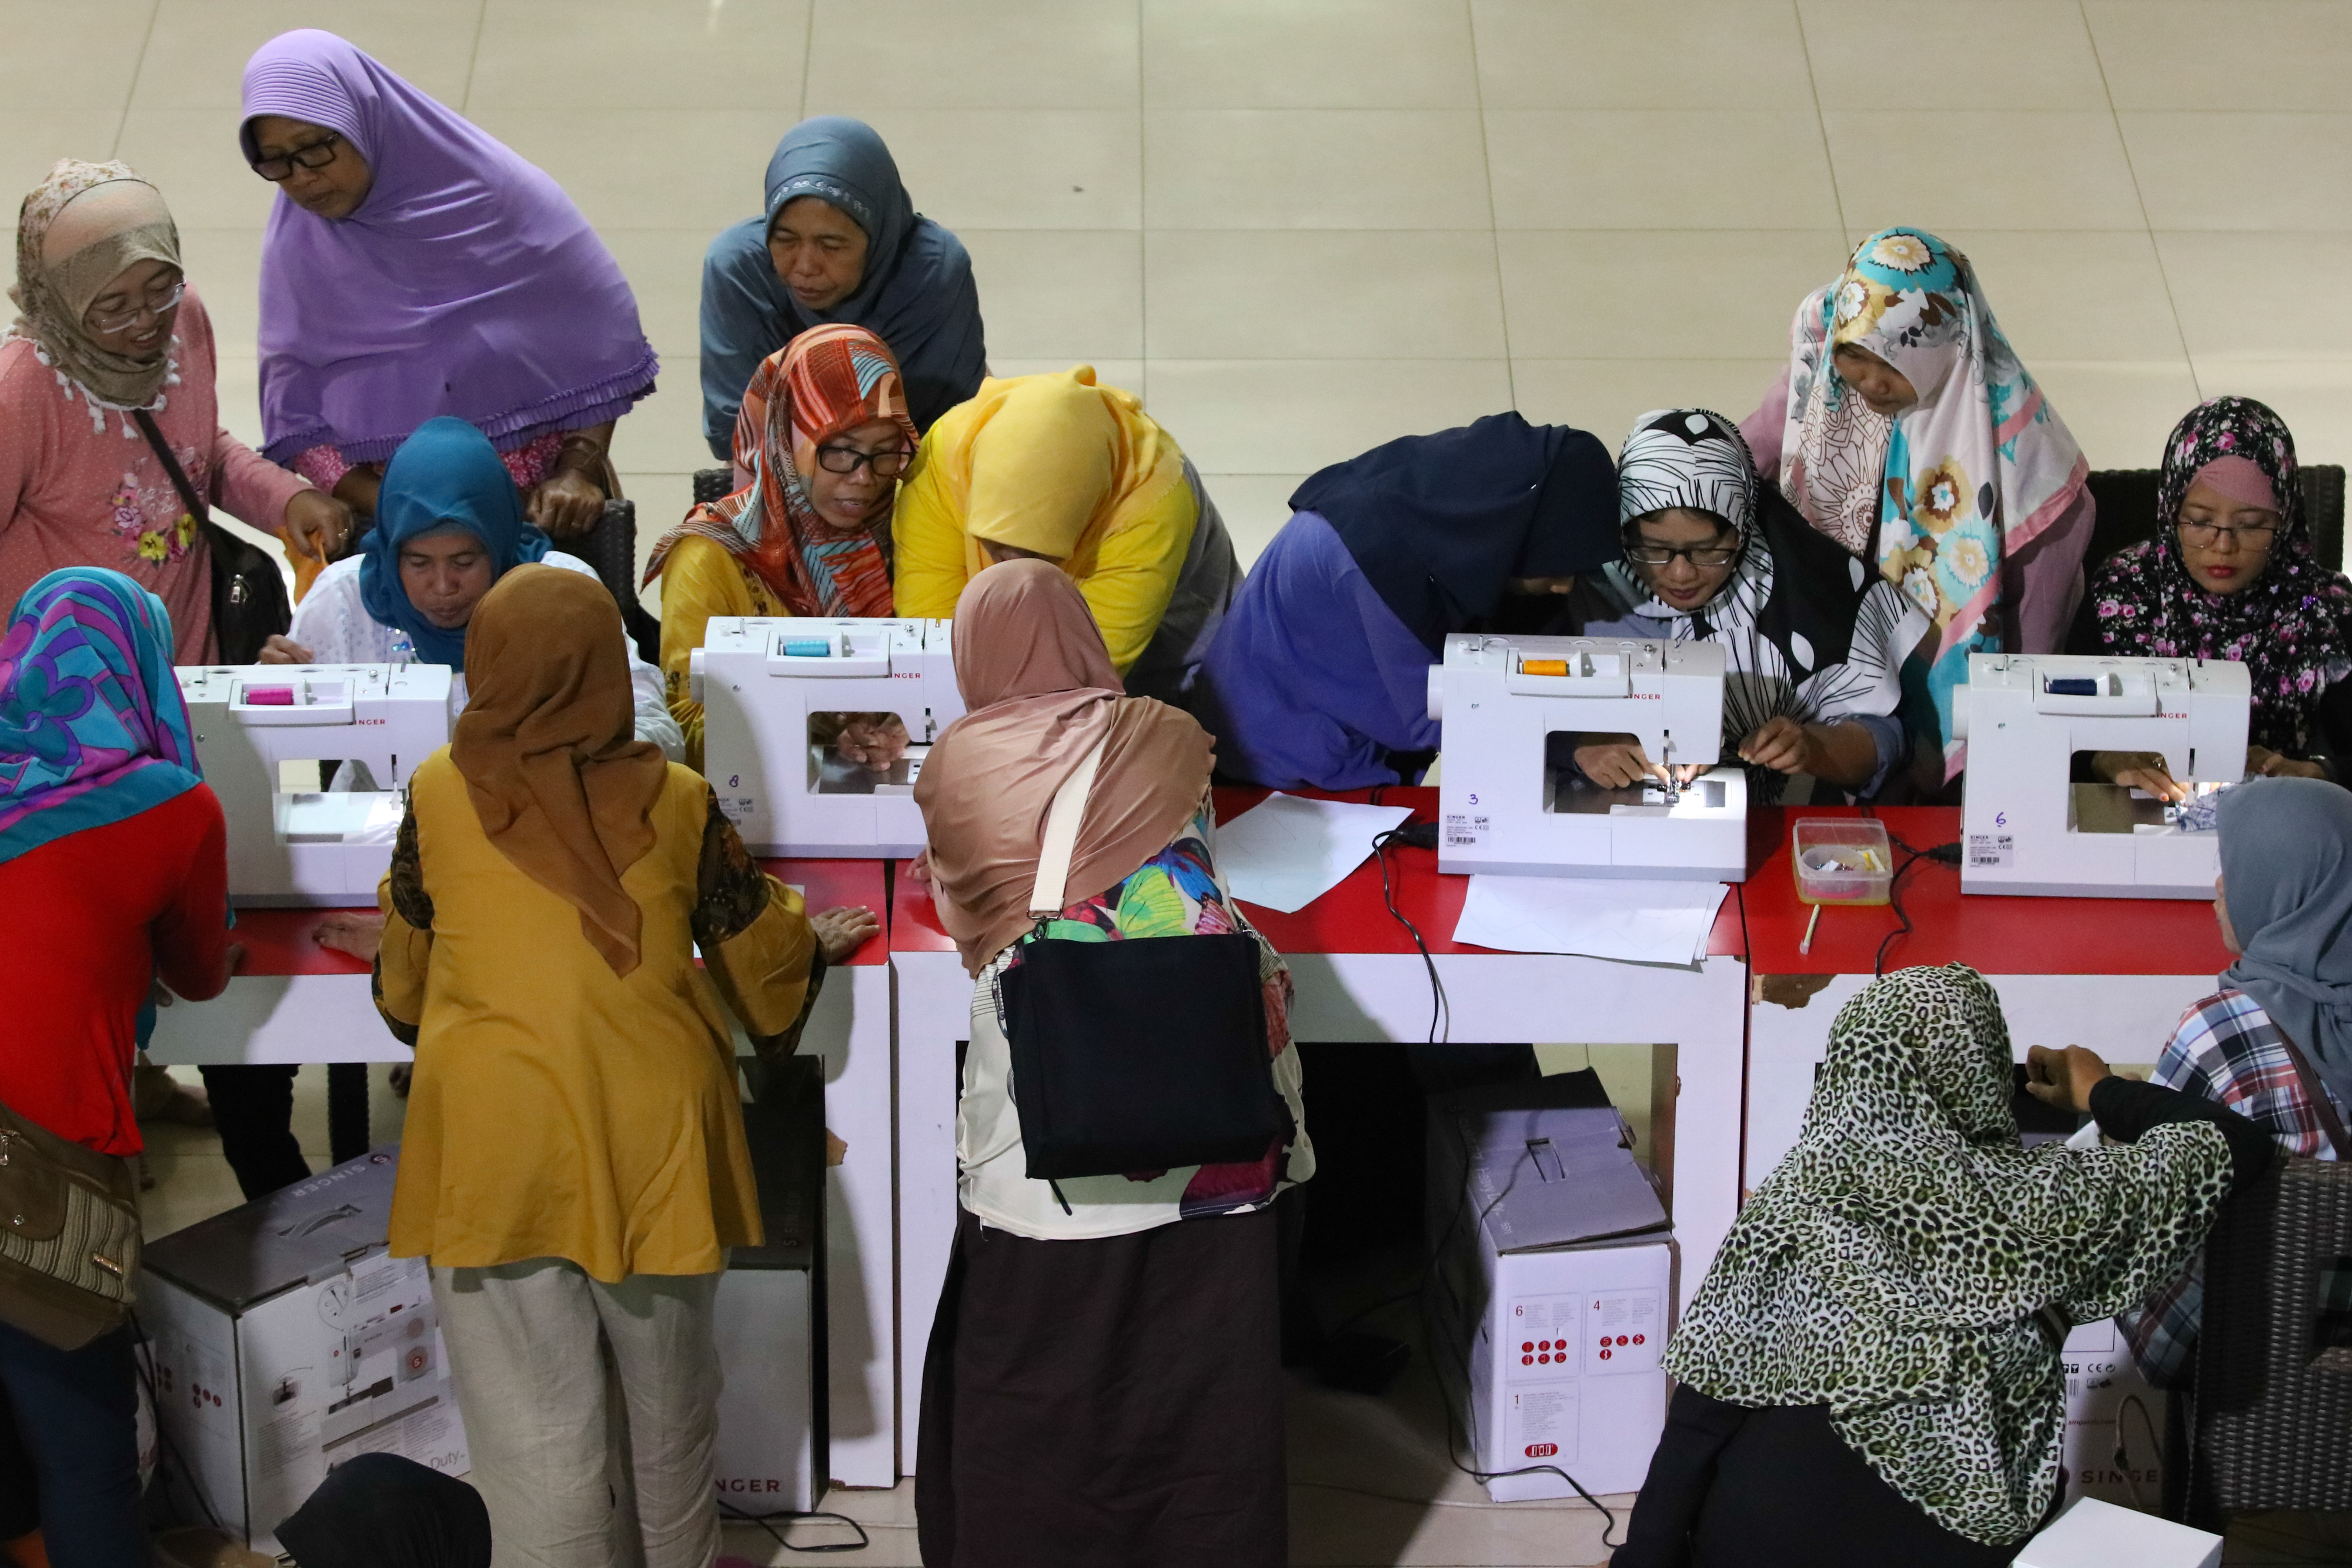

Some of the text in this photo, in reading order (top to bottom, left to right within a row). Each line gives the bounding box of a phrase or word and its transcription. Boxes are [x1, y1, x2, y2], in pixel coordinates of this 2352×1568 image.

[1468, 794, 1478, 805] 3
[1996, 811, 2006, 825] 6
[291, 1164, 366, 1197] SINGER
[1515, 1306, 1524, 1316] 6
[1593, 1300, 1601, 1311] 4
[1514, 1394, 1519, 1405] 1
[2081, 1469, 2158, 1484] SINGE
[714, 1479, 780, 1492] NGER
